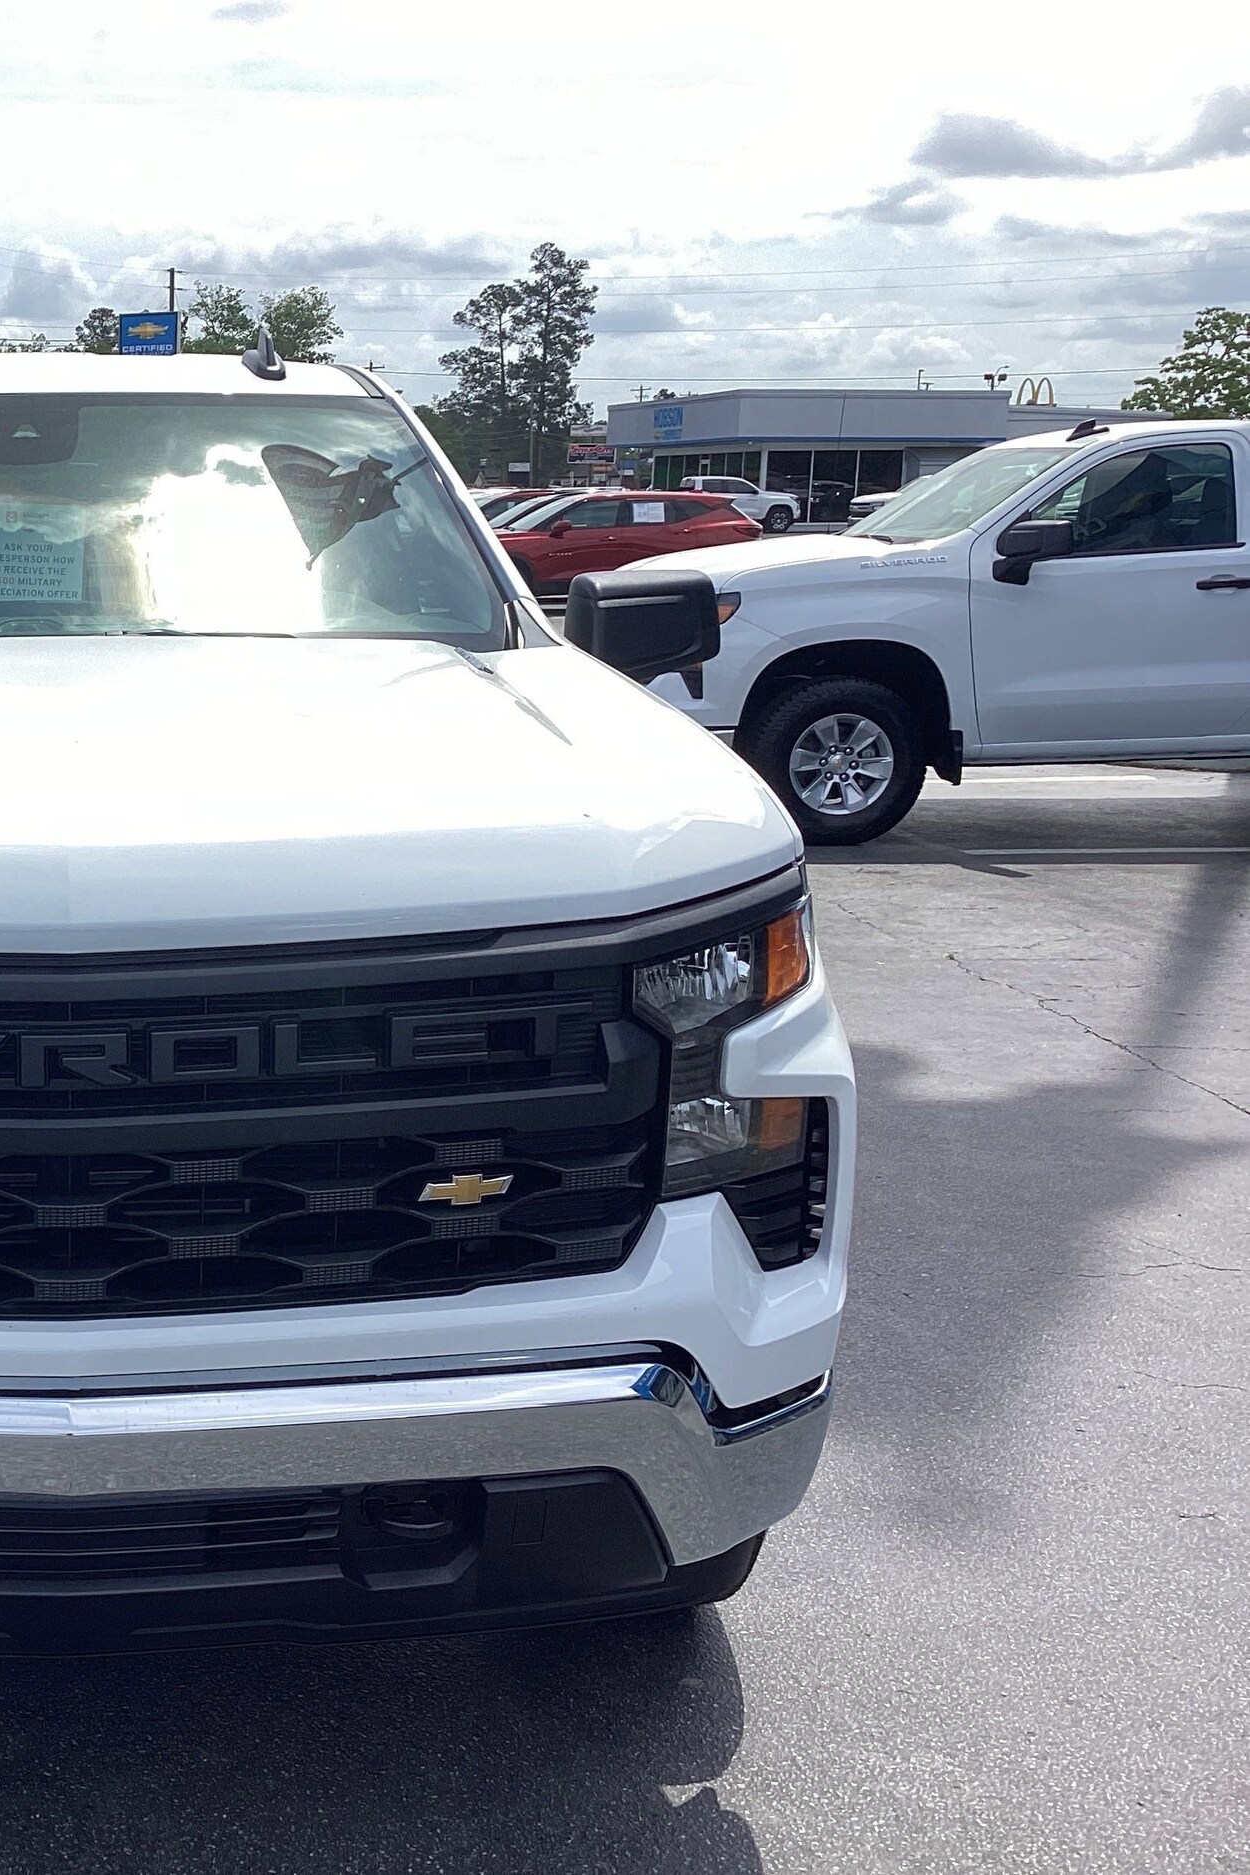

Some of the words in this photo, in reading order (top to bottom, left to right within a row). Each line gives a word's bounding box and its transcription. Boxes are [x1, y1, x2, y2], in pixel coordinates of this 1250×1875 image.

[122, 344, 173, 353] CERTIFIED
[4, 543, 23, 551] ASK
[26, 543, 53, 552] YOUR
[53, 556, 75, 564] HOW
[859, 555, 947, 570] SILVERADO
[4, 565, 44, 575] RECEIVE
[47, 567, 67, 576] THE
[18, 577, 62, 587] MILITARY
[47, 590, 78, 599] OFFER
